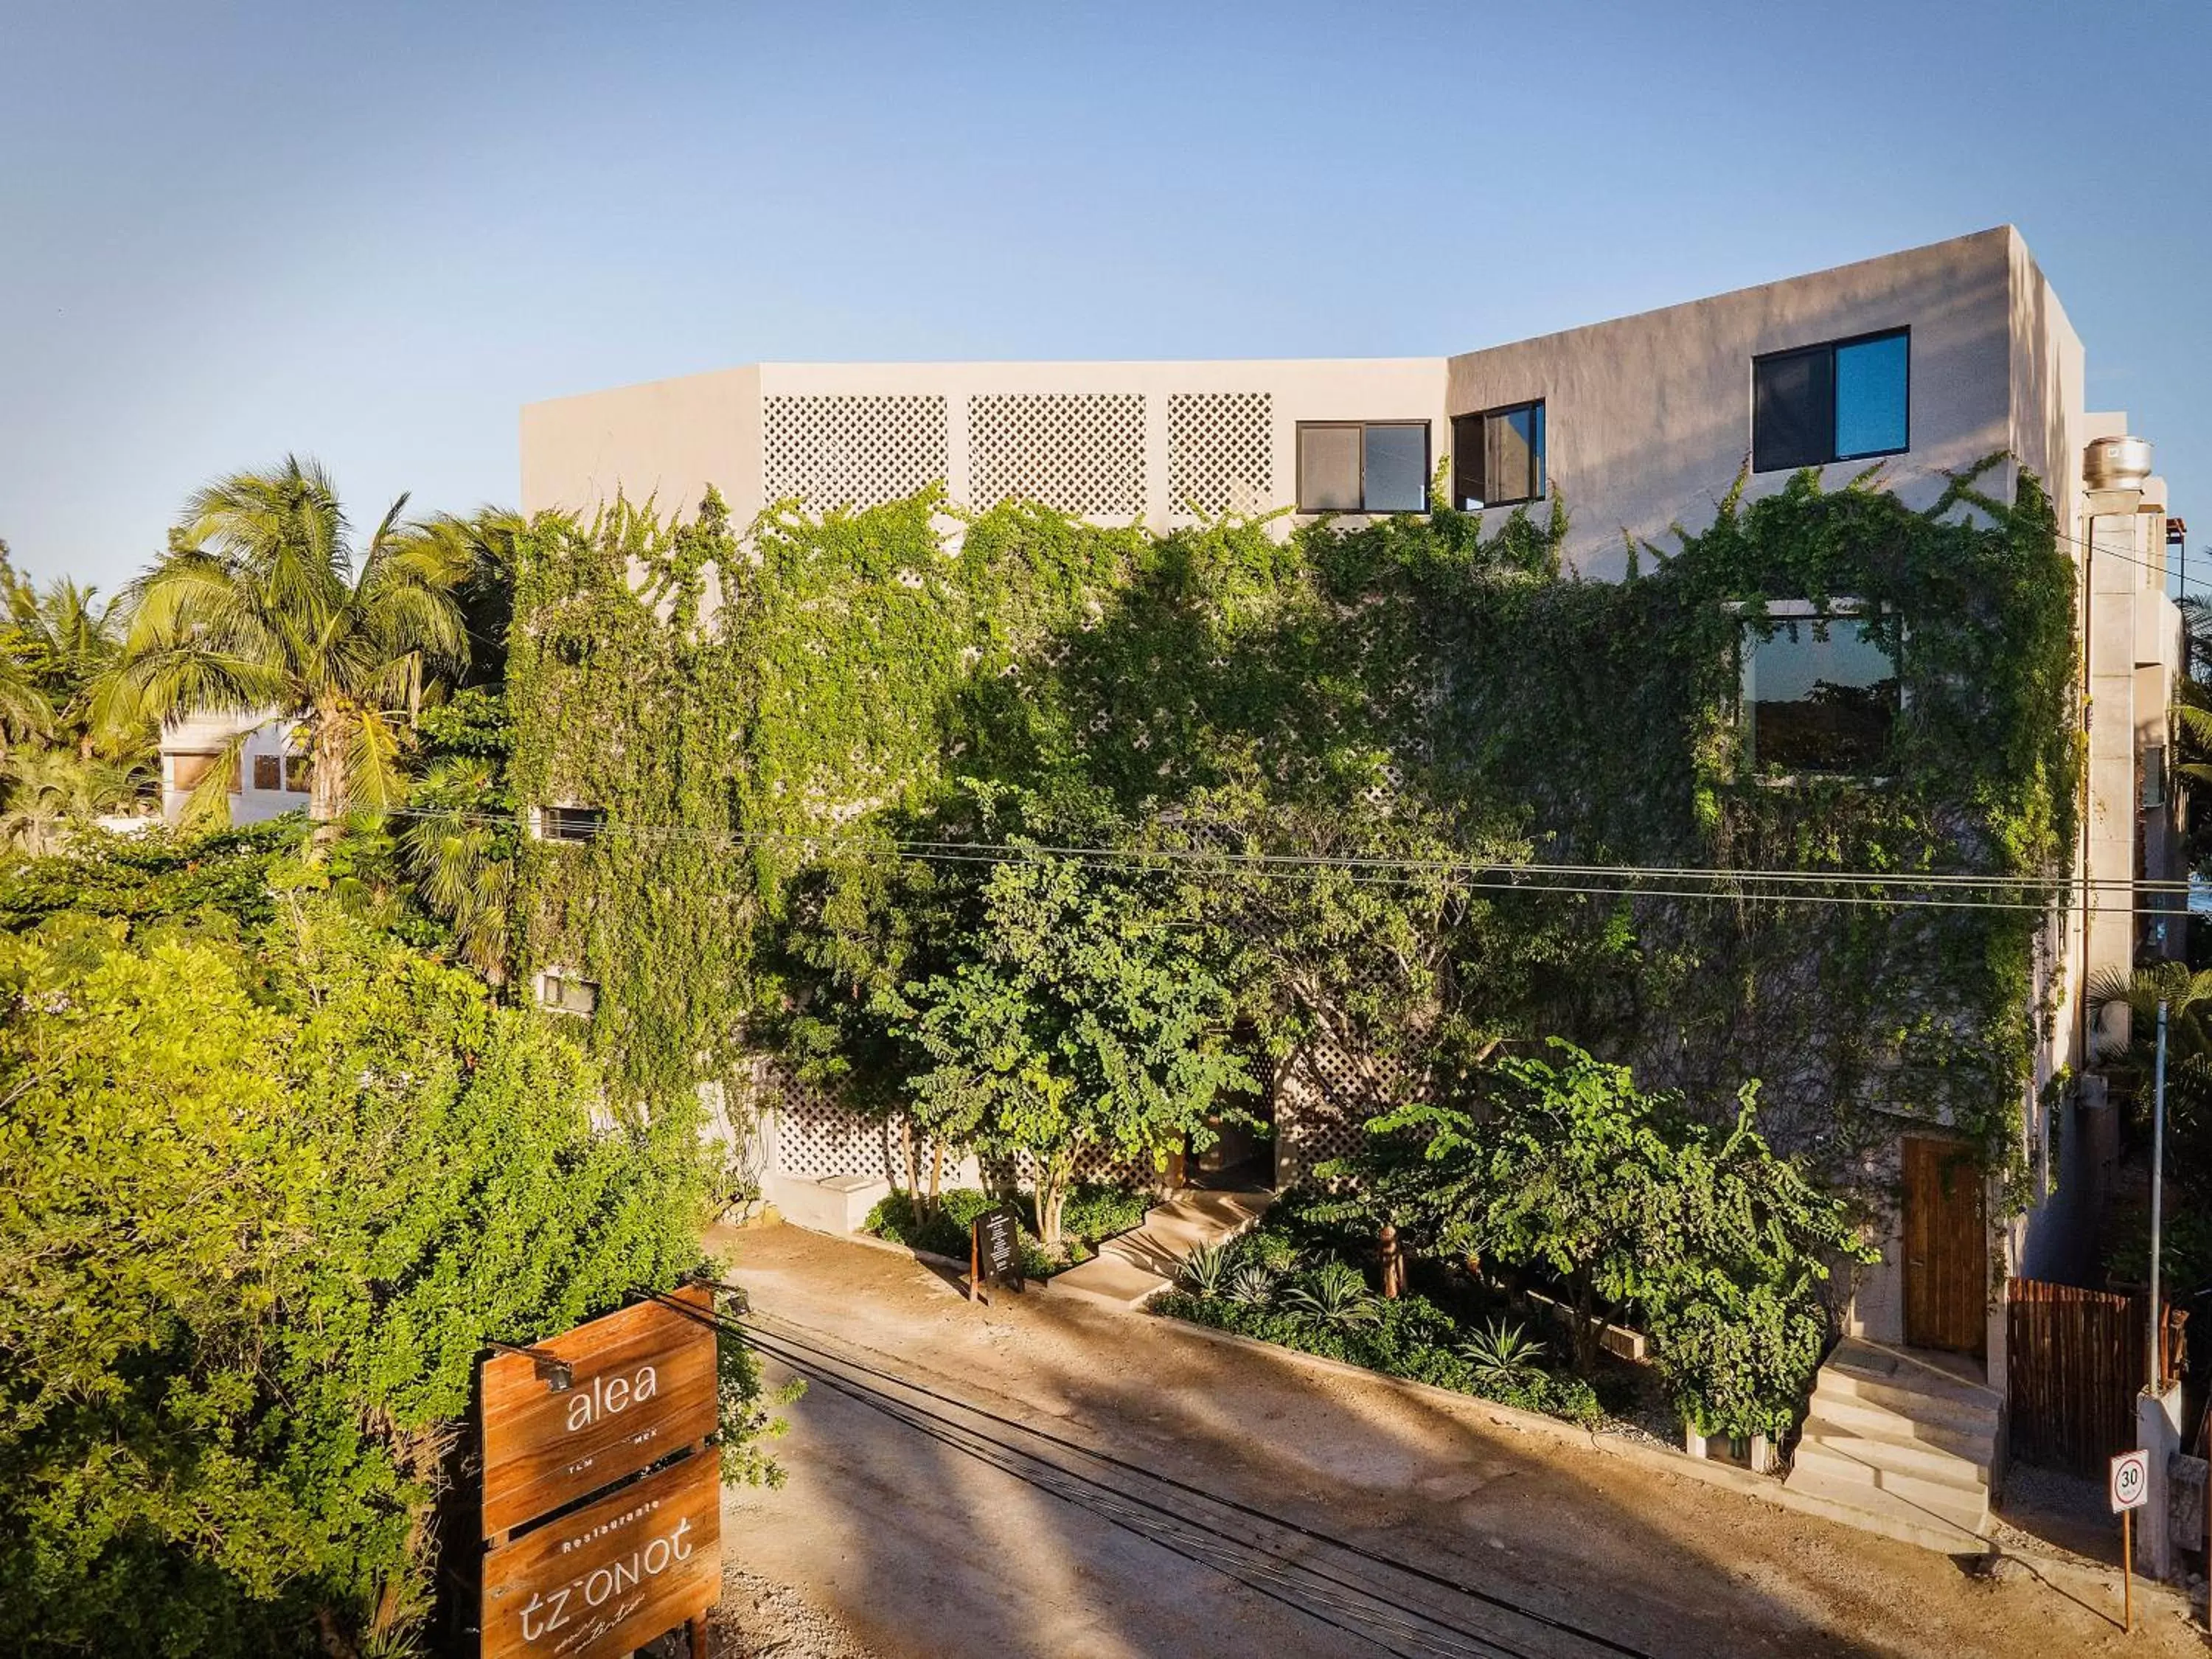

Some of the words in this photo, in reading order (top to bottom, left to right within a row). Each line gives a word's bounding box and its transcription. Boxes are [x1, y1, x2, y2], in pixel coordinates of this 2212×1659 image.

[567, 1366, 656, 1431] alea
[2121, 1468, 2138, 1488] 30
[562, 1500, 660, 1554] Restaurante
